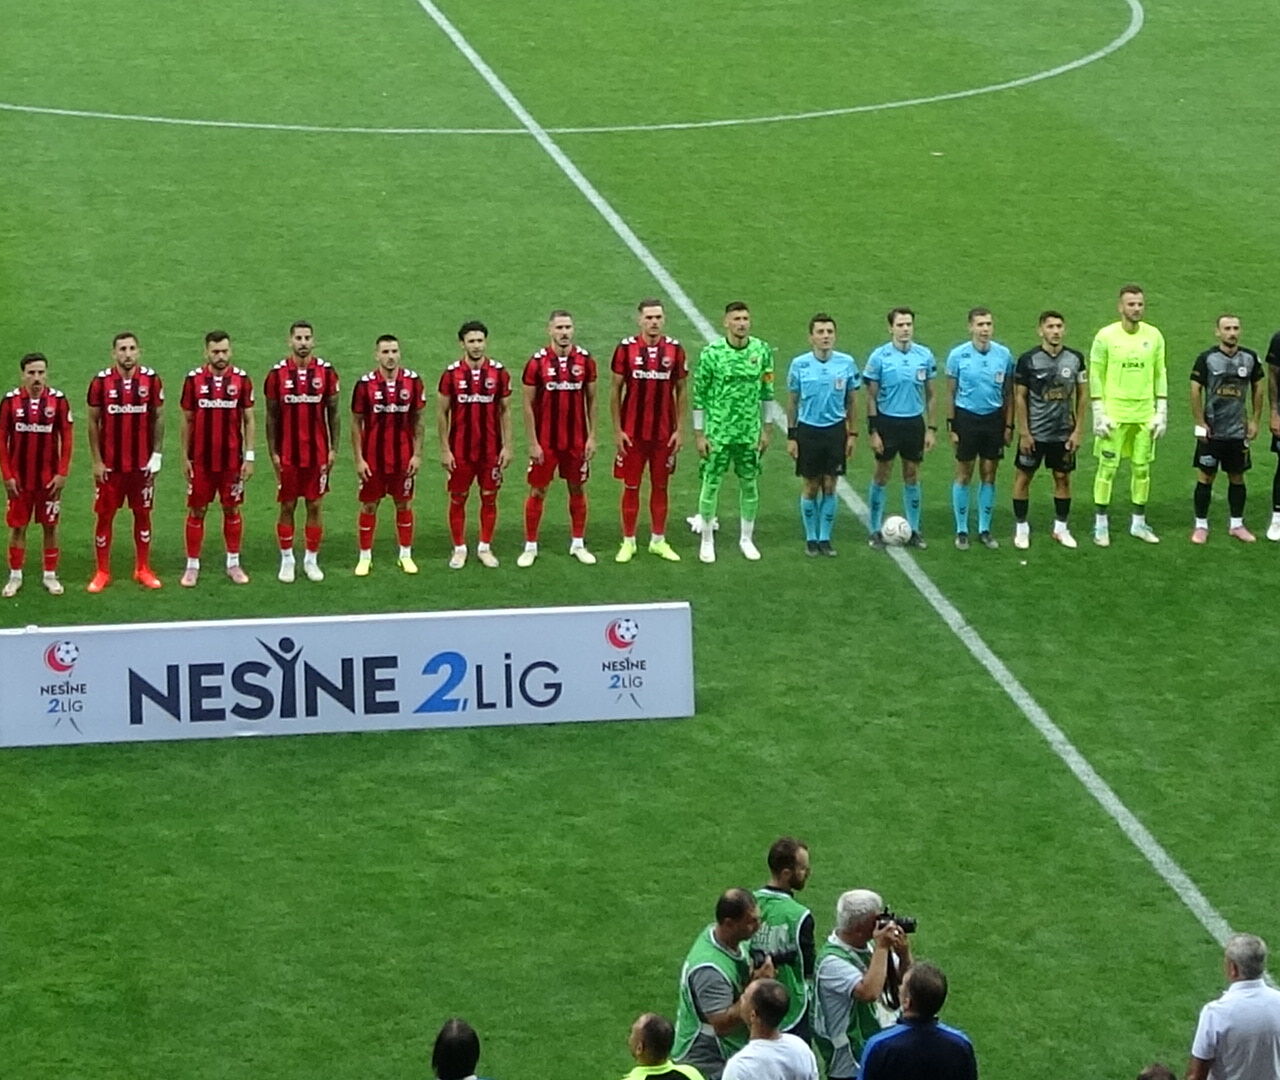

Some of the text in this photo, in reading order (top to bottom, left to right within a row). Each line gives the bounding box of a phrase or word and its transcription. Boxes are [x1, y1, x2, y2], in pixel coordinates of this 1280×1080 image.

[601, 657, 647, 672] NESİNE
[128, 636, 399, 725] NESİNE
[40, 681, 87, 696] NESİNE
